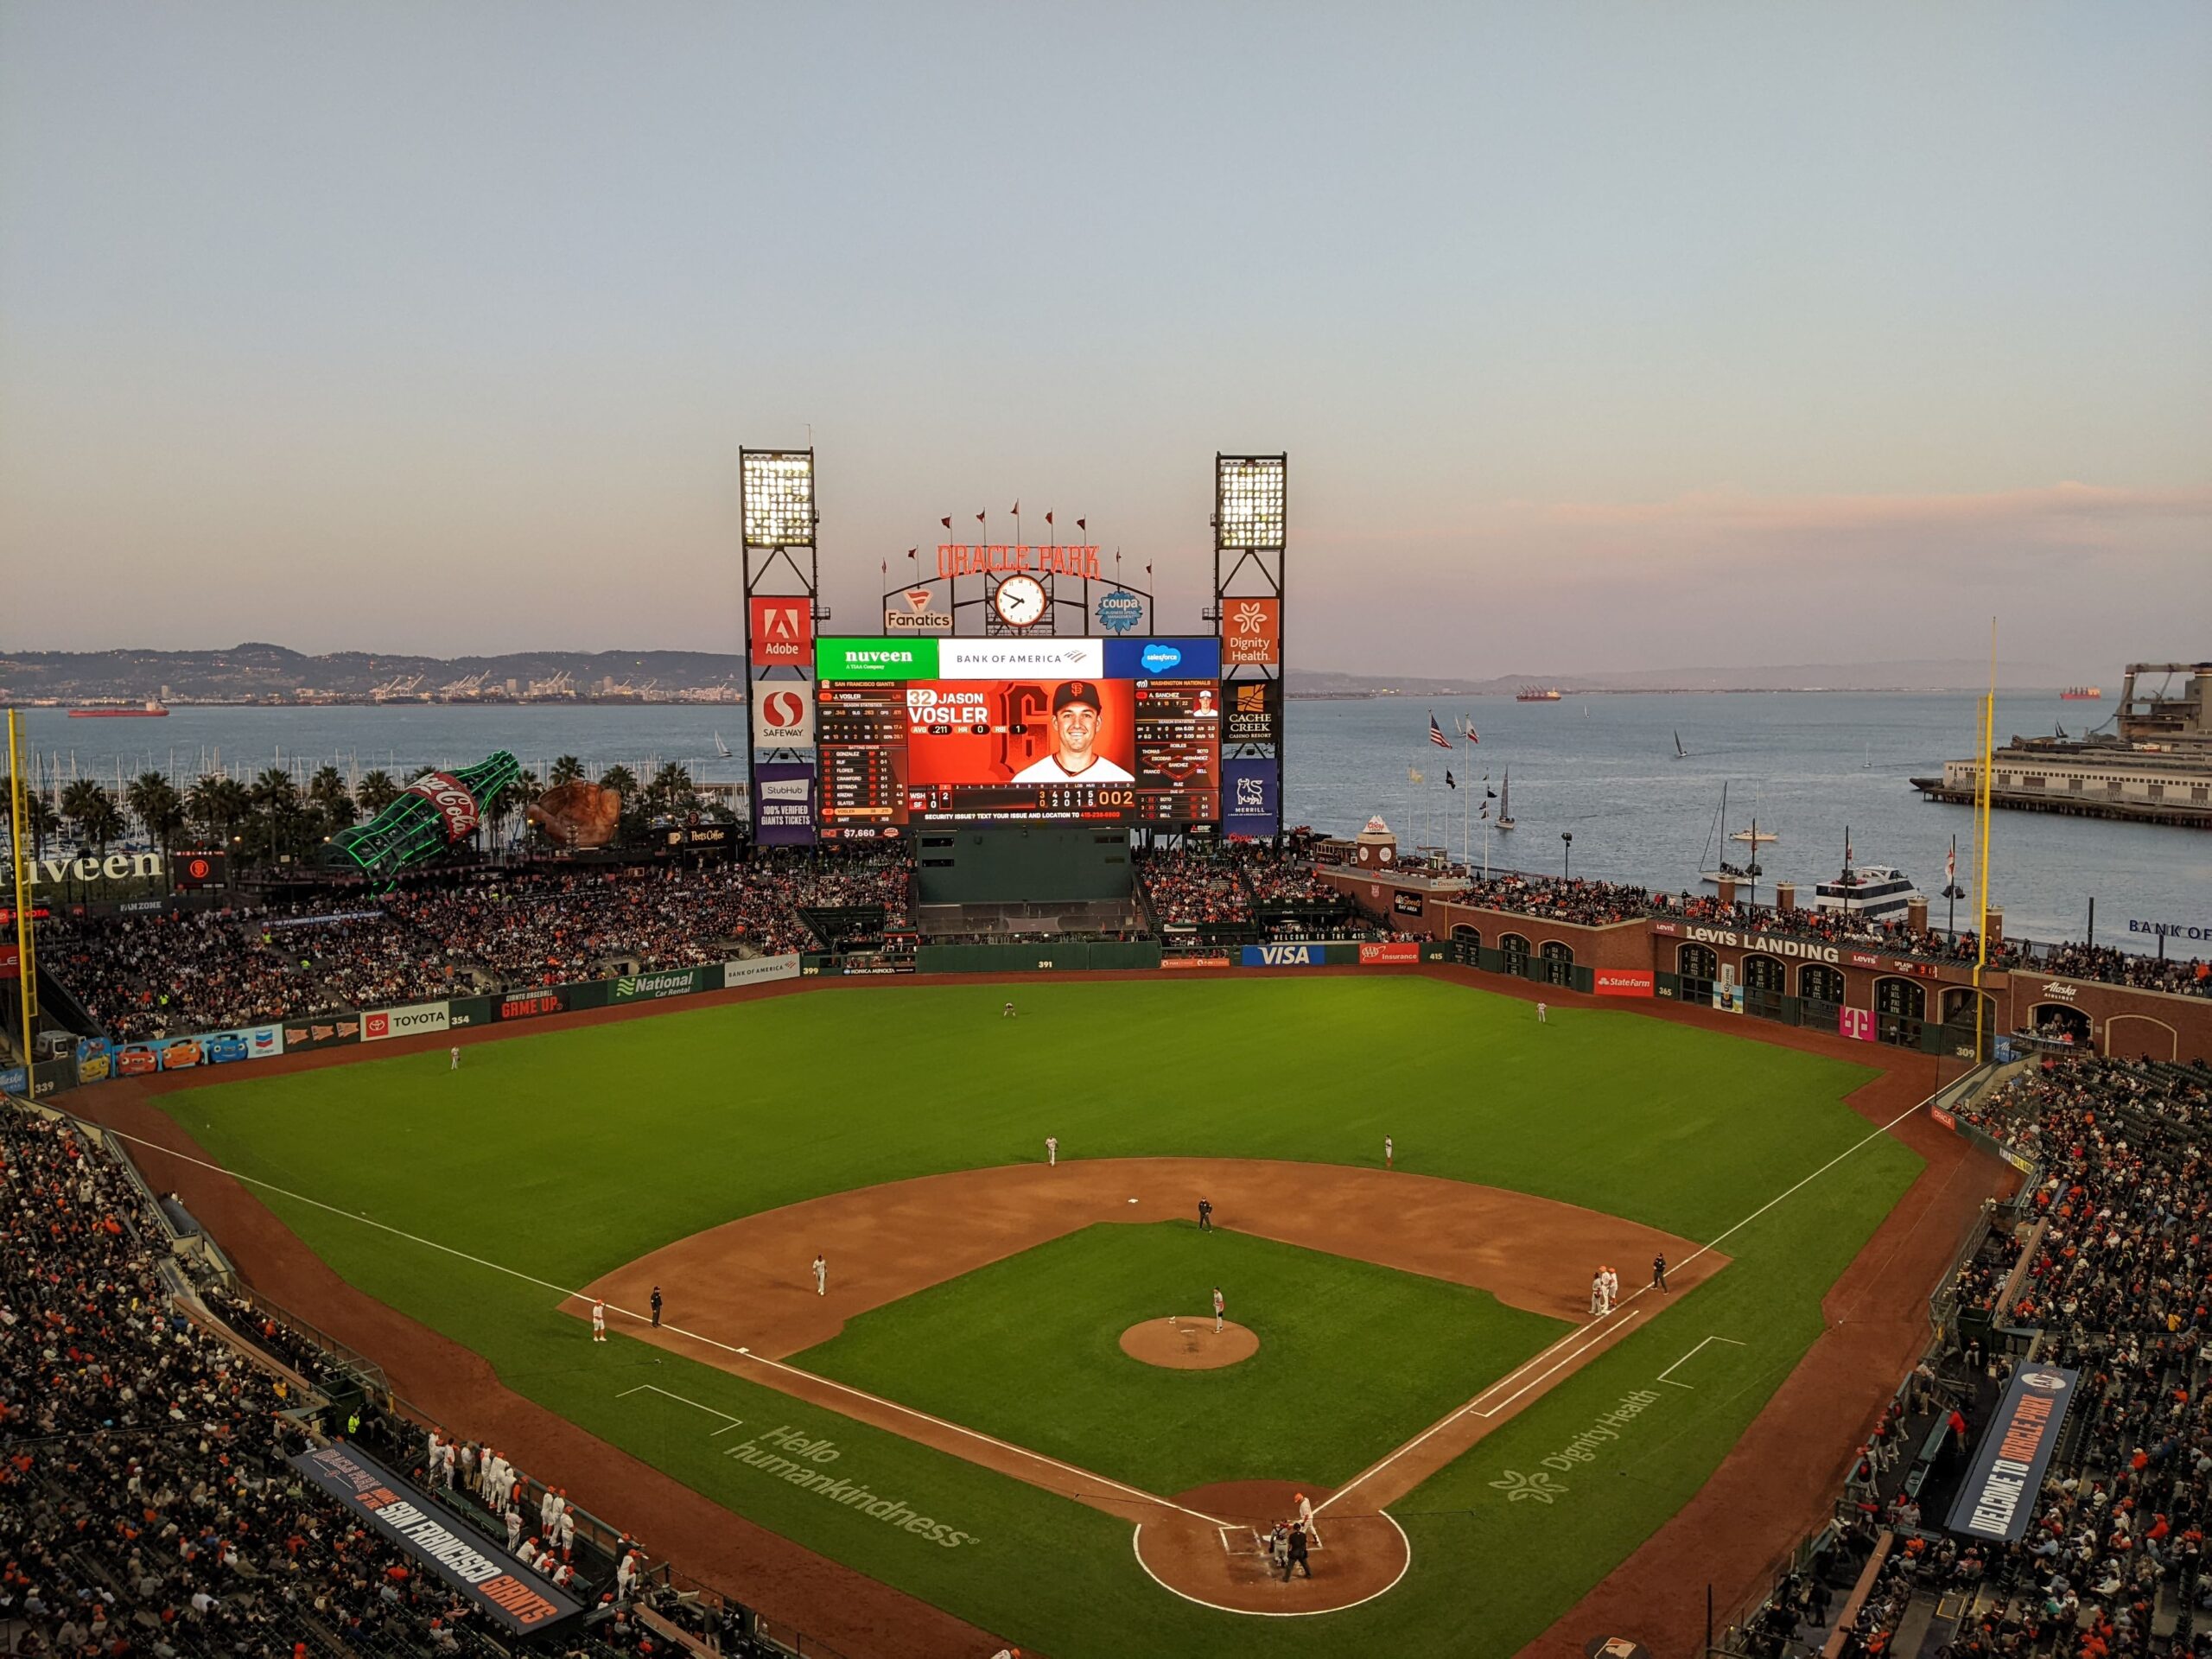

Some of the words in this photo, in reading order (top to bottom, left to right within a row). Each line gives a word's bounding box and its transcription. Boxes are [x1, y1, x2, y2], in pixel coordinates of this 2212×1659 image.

[938, 545, 1030, 578] ORACLE
[1038, 545, 1101, 580] PARK
[1103, 599, 1138, 611] coupa
[888, 612, 950, 626] Fanatics
[766, 643, 798, 654] Adobe
[1230, 637, 1270, 651] Dignity
[845, 652, 912, 662] nuveen
[1147, 654, 1178, 663] salesforce
[910, 690, 931, 705] 32
[938, 693, 983, 704] JASON
[908, 707, 988, 723] VOSLER
[1229, 714, 1272, 722] CACHE
[763, 728, 803, 737] SAFEWAY
[1230, 723, 1270, 732] CREEK
[763, 805, 780, 815] 100%
[781, 805, 808, 815] VERIFIED
[761, 816, 784, 825] GIANTS
[785, 816, 810, 825] TICKETS
[691, 830, 706, 842] Peet's
[706, 830, 724, 841] Coffee
[844, 829, 874, 837] $7,660
[1229, 832, 1253, 842] Coors
[138, 901, 162, 910] ZONE
[1403, 896, 1421, 906] Sports
[2129, 919, 2181, 938] BANK
[2188, 926, 2212, 940] OF
[1363, 947, 1378, 957] AAA
[1744, 934, 1839, 963] LANDING
[1258, 947, 1310, 964] VISA
[728, 969, 745, 978] BANK
[756, 965, 784, 975] AMERICA
[803, 967, 819, 976] 399
[635, 972, 694, 993] National
[2043, 982, 2077, 995] Alaska
[506, 993, 525, 1002] GIANTS
[526, 989, 553, 1000] BASEBALL
[668, 987, 690, 996] Rental
[1659, 987, 1672, 995] 365
[501, 1000, 537, 1018] GAME
[542, 995, 557, 1011] UP
[394, 1011, 445, 1027] TOYOTA
[451, 1015, 469, 1026] 354
[1956, 1048, 1975, 1058] 309
[35, 1081, 54, 1093] 339
[2014, 1394, 2054, 1423] PARK
[1540, 1419, 1620, 1471] Dignity
[1602, 1389, 1662, 1427] Health
[759, 1425, 841, 1463] Hello
[1999, 1421, 2044, 1464] ORACLE
[1993, 1459, 2030, 1478] TO
[1969, 1473, 2024, 1535] WELCOME
[374, 1501, 421, 1534] SAN
[401, 1512, 503, 1583] FRANCISCO
[477, 1575, 559, 1624] GIANTS
